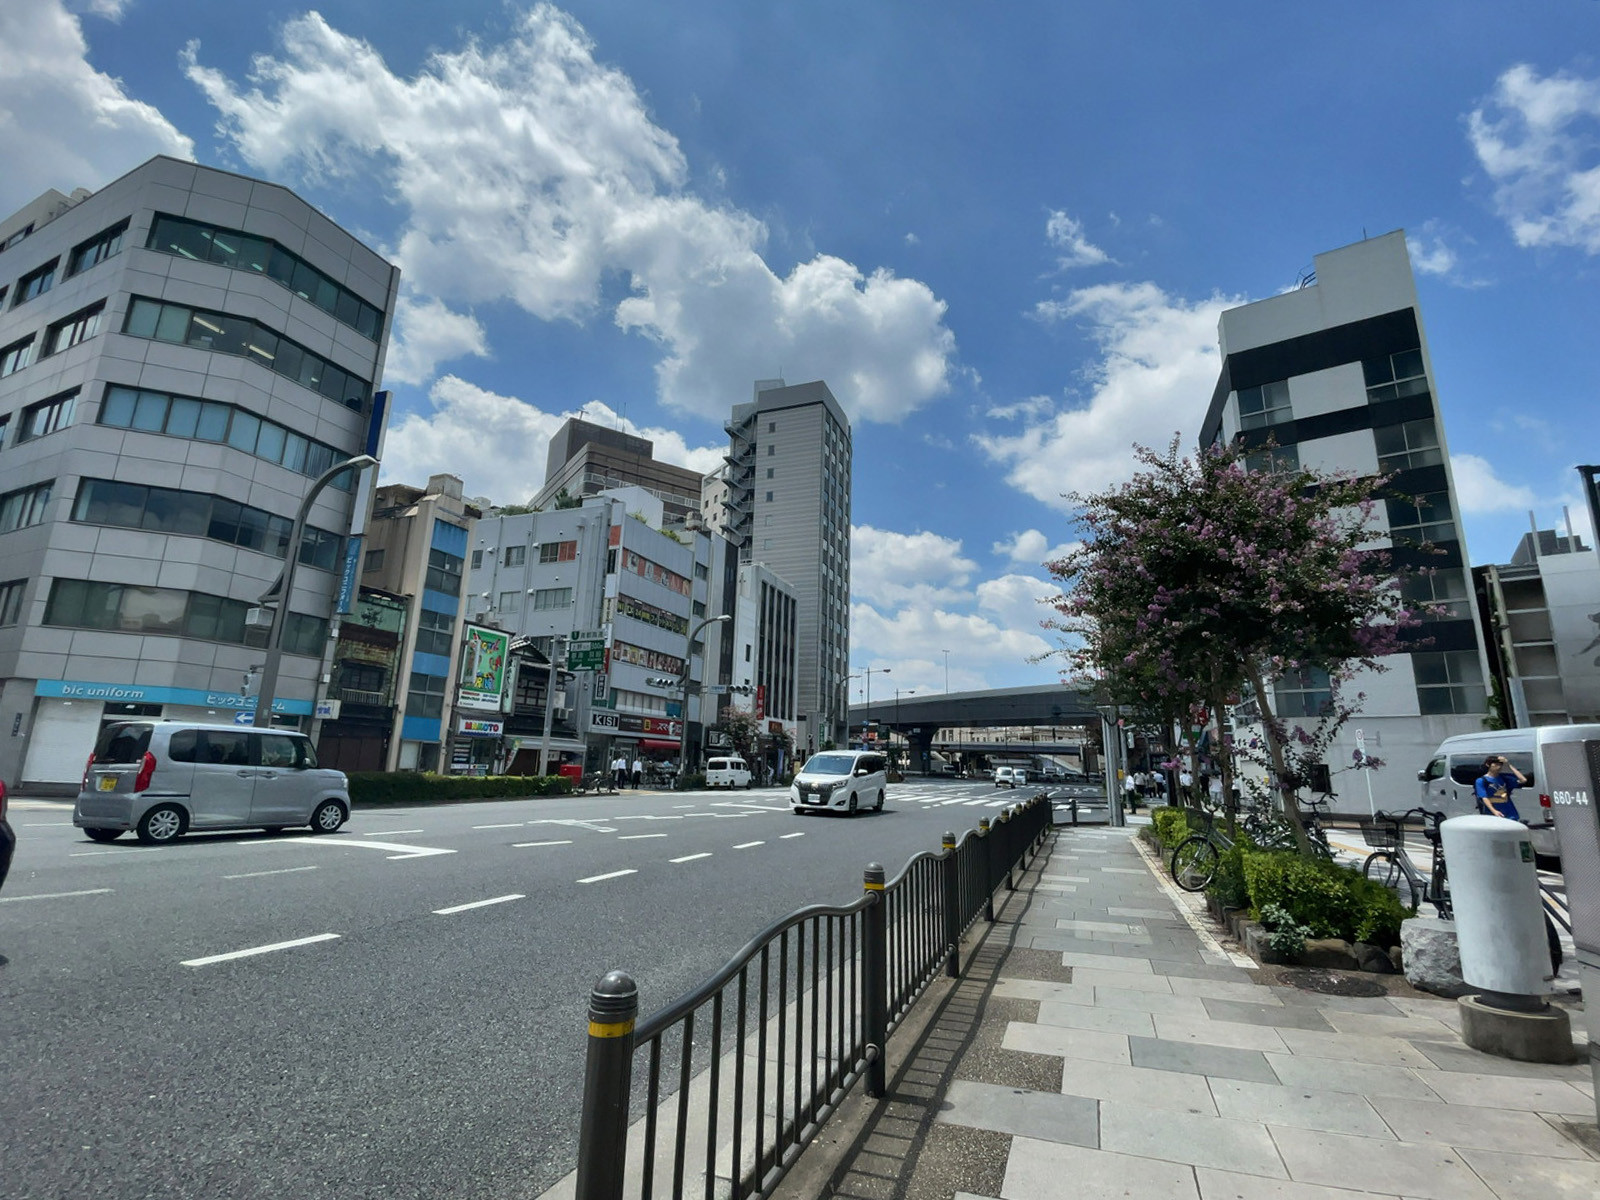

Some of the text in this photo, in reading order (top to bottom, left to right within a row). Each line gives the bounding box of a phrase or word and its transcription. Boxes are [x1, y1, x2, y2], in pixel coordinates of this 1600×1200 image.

[62, 684, 144, 698] bic uniform
[595, 715, 616, 726] KISI
[1553, 790, 1588, 805] 660-44
